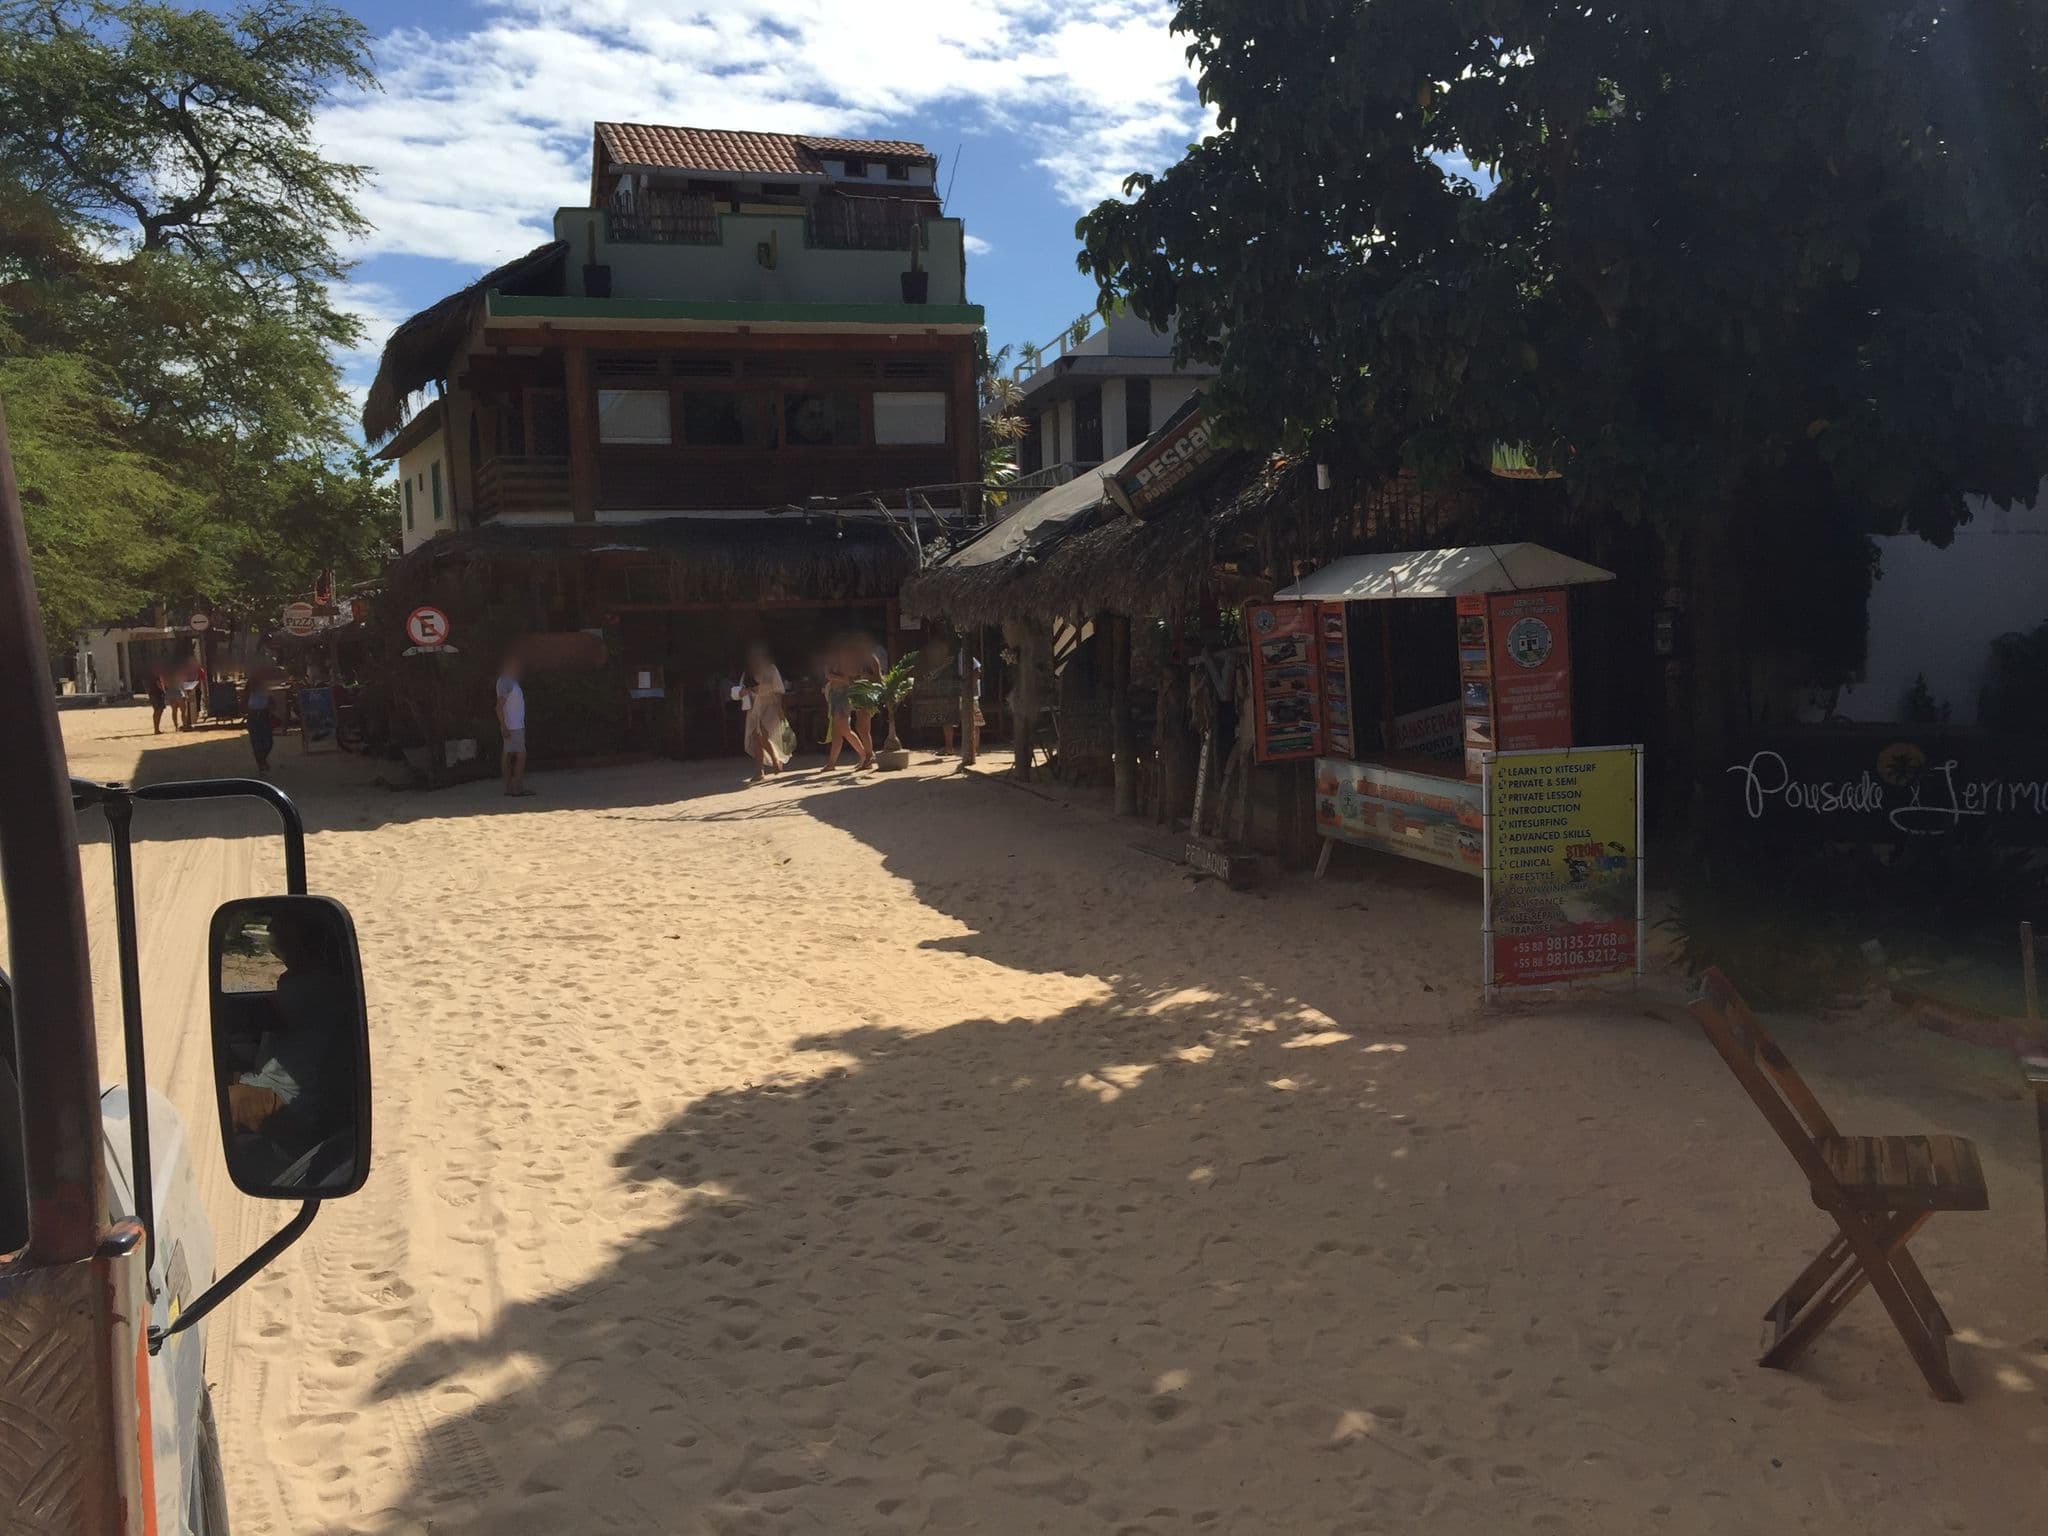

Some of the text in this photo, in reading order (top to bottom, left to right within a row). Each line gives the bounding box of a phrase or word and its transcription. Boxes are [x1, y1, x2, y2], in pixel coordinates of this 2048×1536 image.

[420, 614, 435, 637] E
[1508, 763, 1597, 777] LEARN TO KITESURF
[1508, 778, 1545, 789] PRIVATE
[1556, 777, 1578, 786] SEMI
[1725, 750, 1884, 819] Pousada
[1508, 790, 1582, 802] PRIVATE LESSON
[1508, 803, 1581, 816] INTRODUCTION
[1509, 817, 1568, 829] KITESURFING
[1509, 828, 1592, 843] ADVANCED SKILLS
[1509, 845, 1554, 856] TRAINING
[1509, 858, 1552, 869] CLINICAL
[1509, 871, 1555, 881] FREESTYLE
[1546, 948, 1618, 967] 98106.9212
